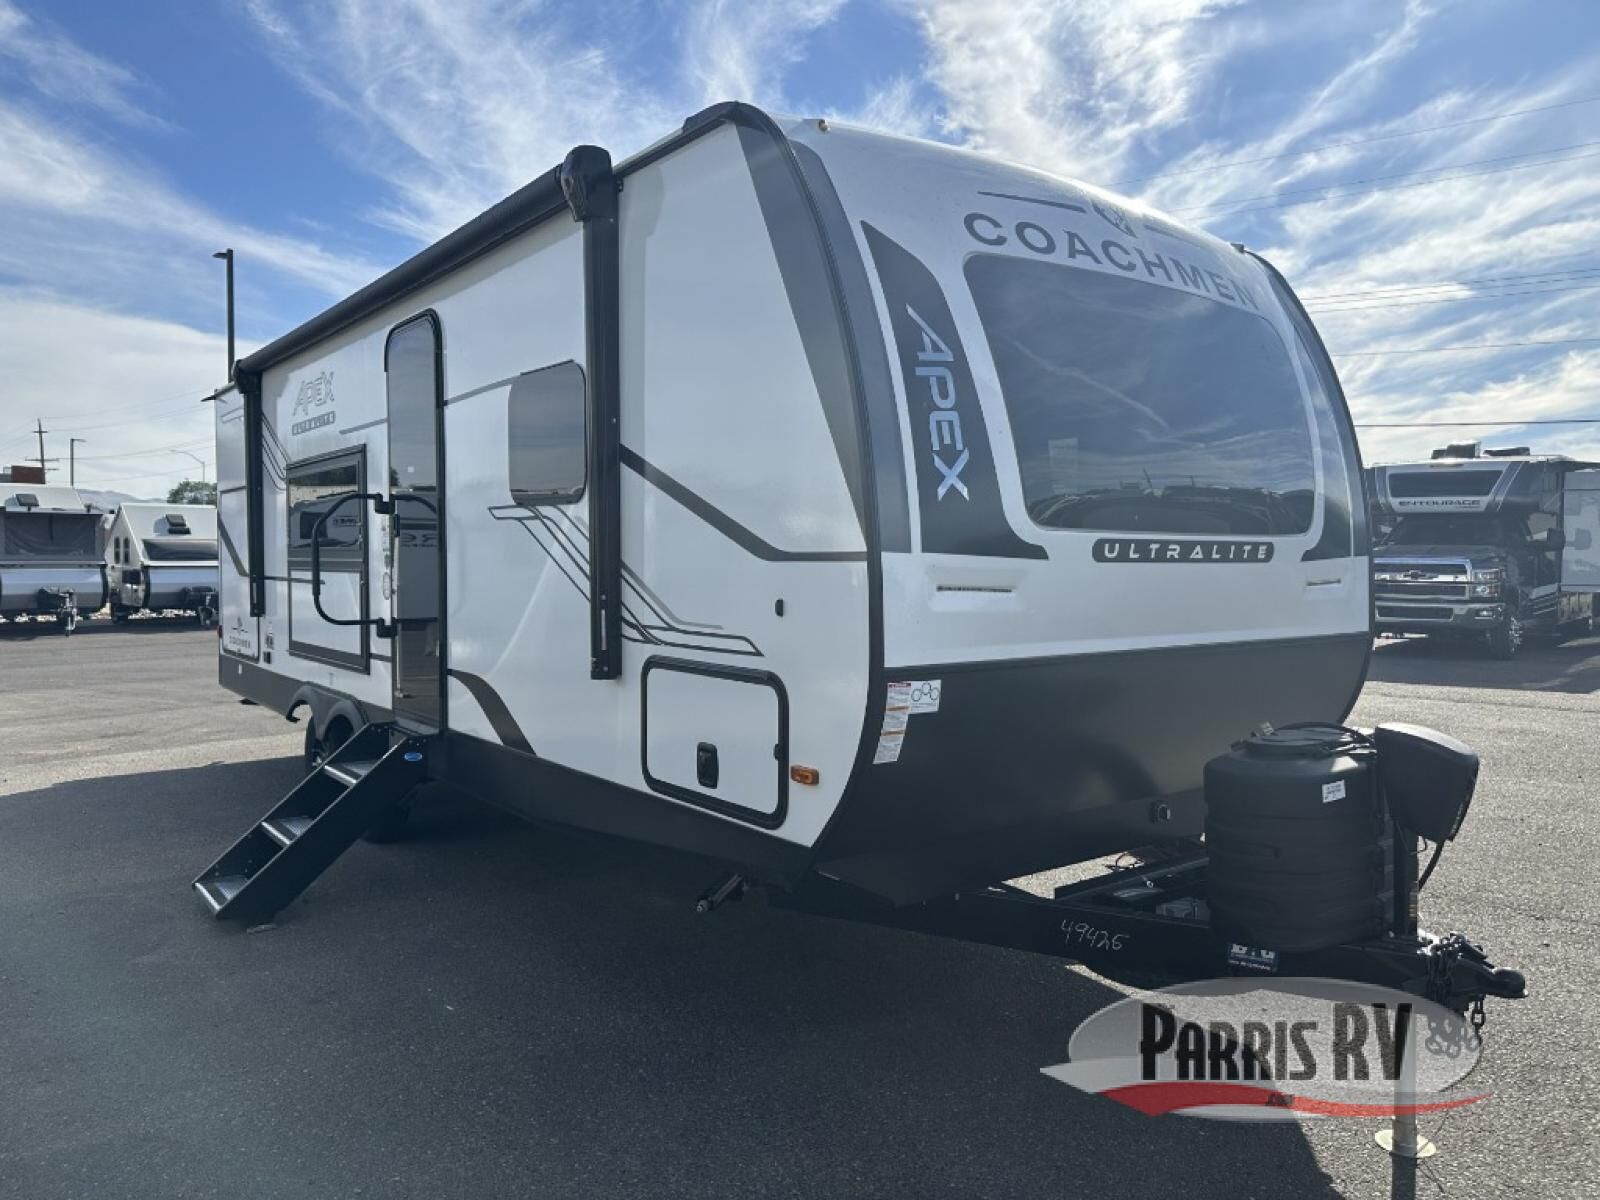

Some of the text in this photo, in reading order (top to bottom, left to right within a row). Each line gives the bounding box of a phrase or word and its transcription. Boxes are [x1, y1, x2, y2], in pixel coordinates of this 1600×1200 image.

[963, 211, 1259, 311] COACHMEN
[291, 371, 335, 417] APEX
[905, 303, 970, 501] APEX
[1104, 543, 1268, 560] ULTRALITE
[1061, 919, 1130, 951] 49426
